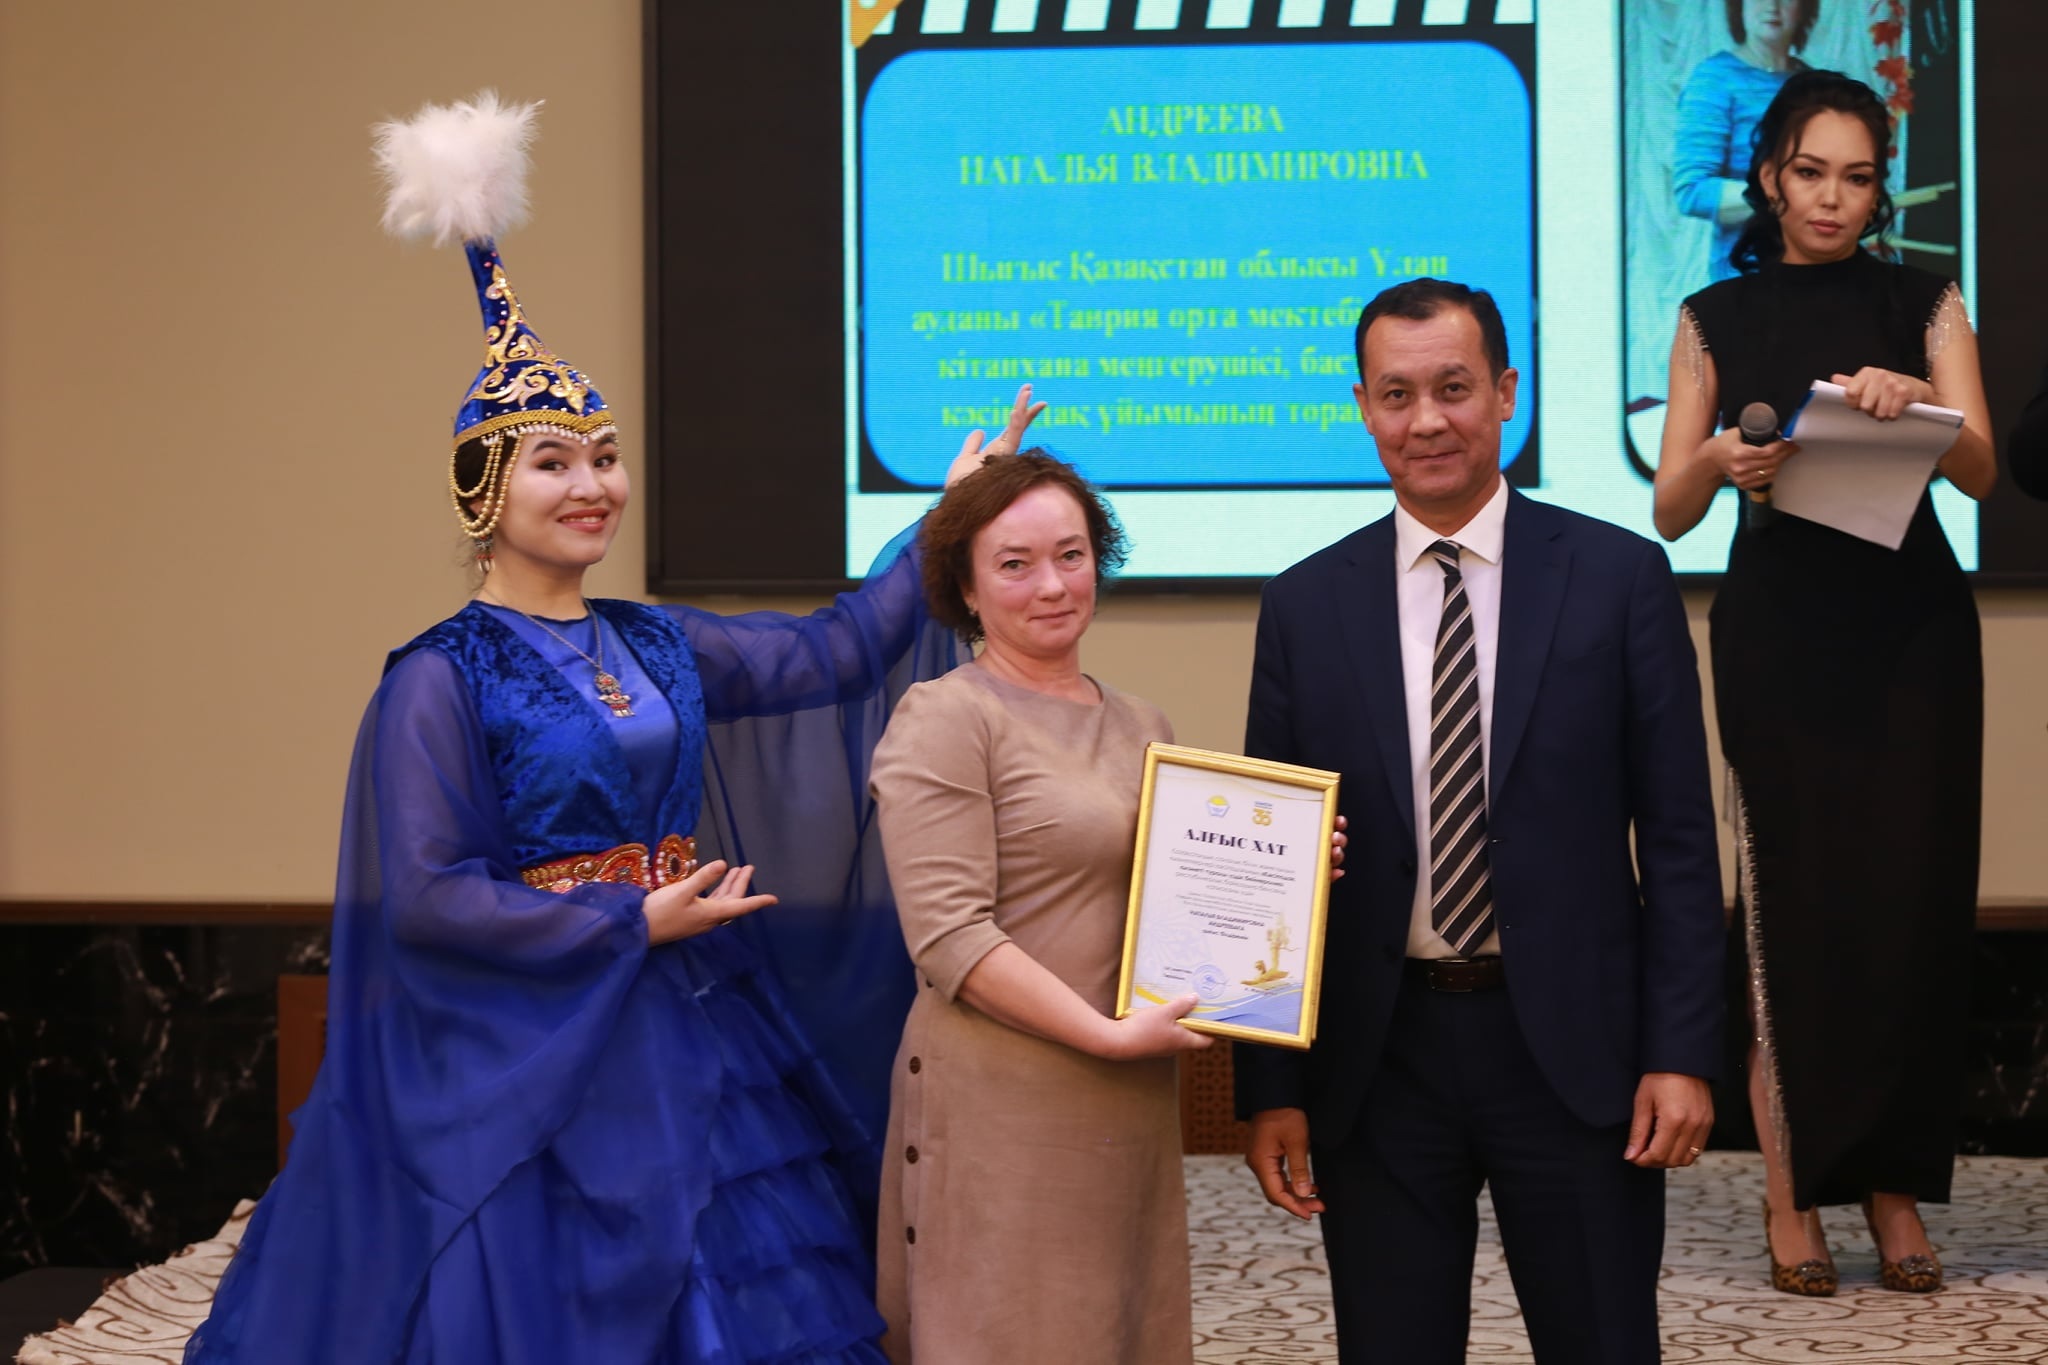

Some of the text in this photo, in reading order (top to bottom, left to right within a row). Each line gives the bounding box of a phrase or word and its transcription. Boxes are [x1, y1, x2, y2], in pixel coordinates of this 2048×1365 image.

[1101, 103, 1286, 138] АНДРЕЕВА
[959, 148, 1430, 186] НАТАЛЬЯ ВЛАДИМИРОВНА
[911, 309, 1020, 340] ауданы
[1167, 305, 1238, 338] орта
[1183, 828, 1289, 857] АЛҒЫС ХАТ
